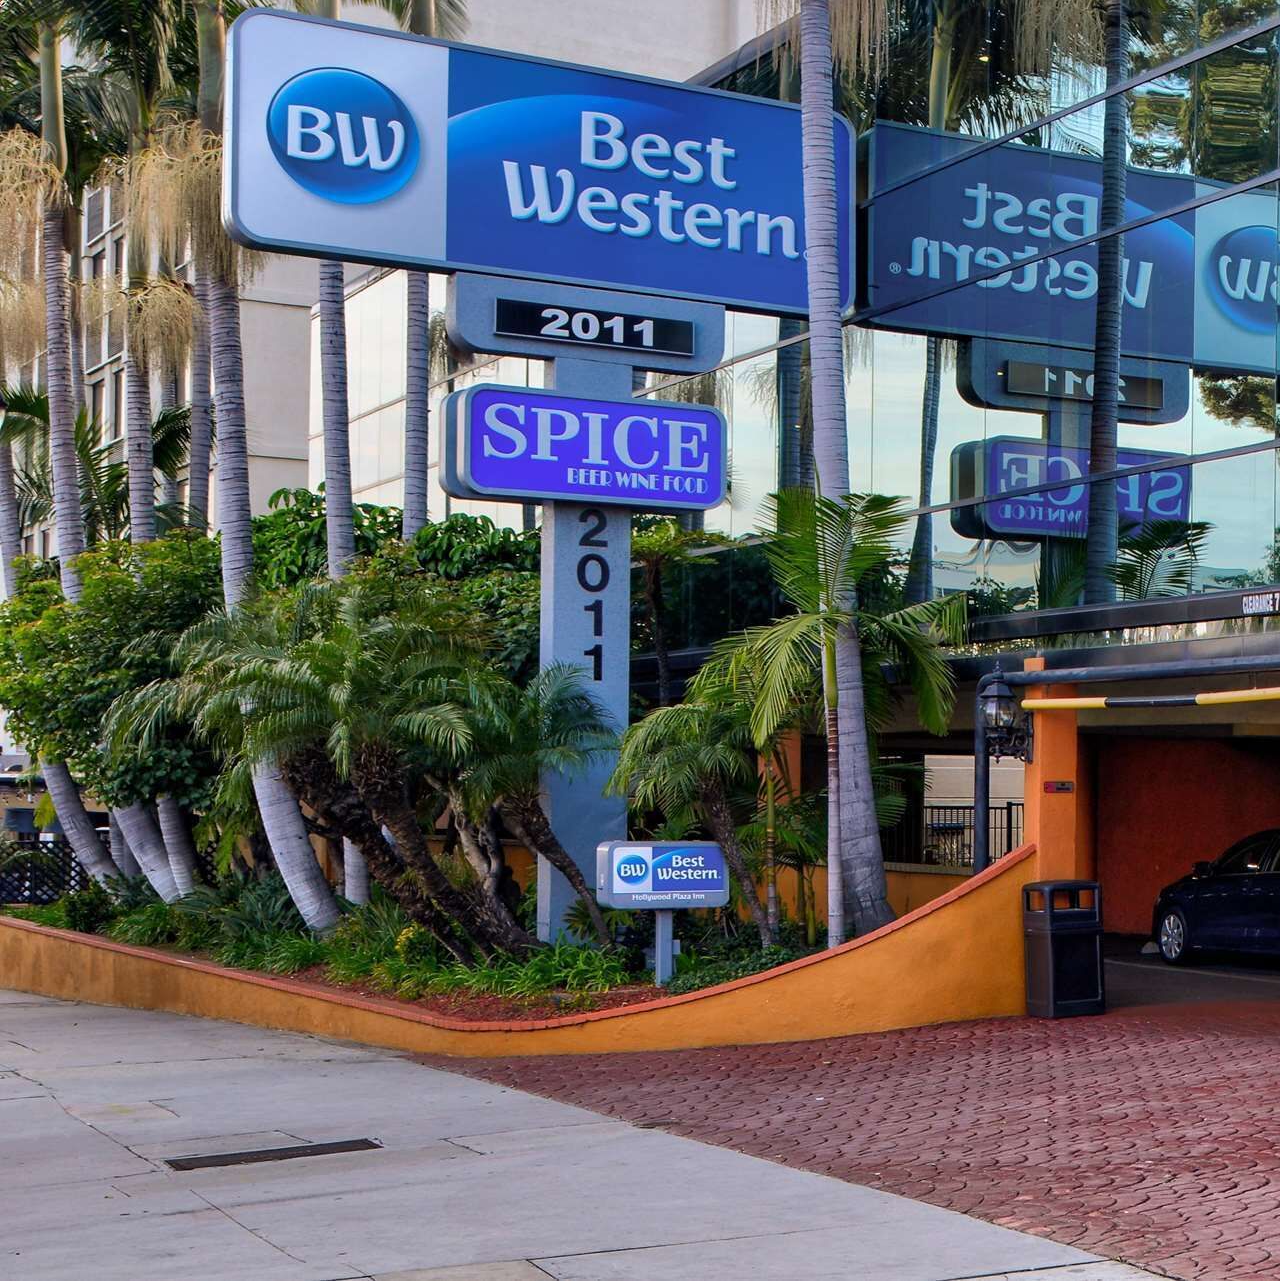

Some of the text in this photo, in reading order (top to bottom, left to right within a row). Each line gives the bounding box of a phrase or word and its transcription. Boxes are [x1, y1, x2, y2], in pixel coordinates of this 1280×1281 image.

[286, 105, 404, 170] BW
[579, 110, 739, 190] Best
[503, 161, 799, 259] Western
[540, 308, 655, 347] 2011
[483, 401, 709, 474] SPICE
[567, 467, 708, 494] BEER WINE FOOD
[576, 508, 610, 681] 2011
[1243, 593, 1273, 615] CLEARANCE
[1274, 592, 1280, 611] 7
[620, 864, 646, 877] BW
[657, 868, 718, 880] Western
[672, 855, 704, 867] Best
[632, 894, 671, 902] Hollywood
